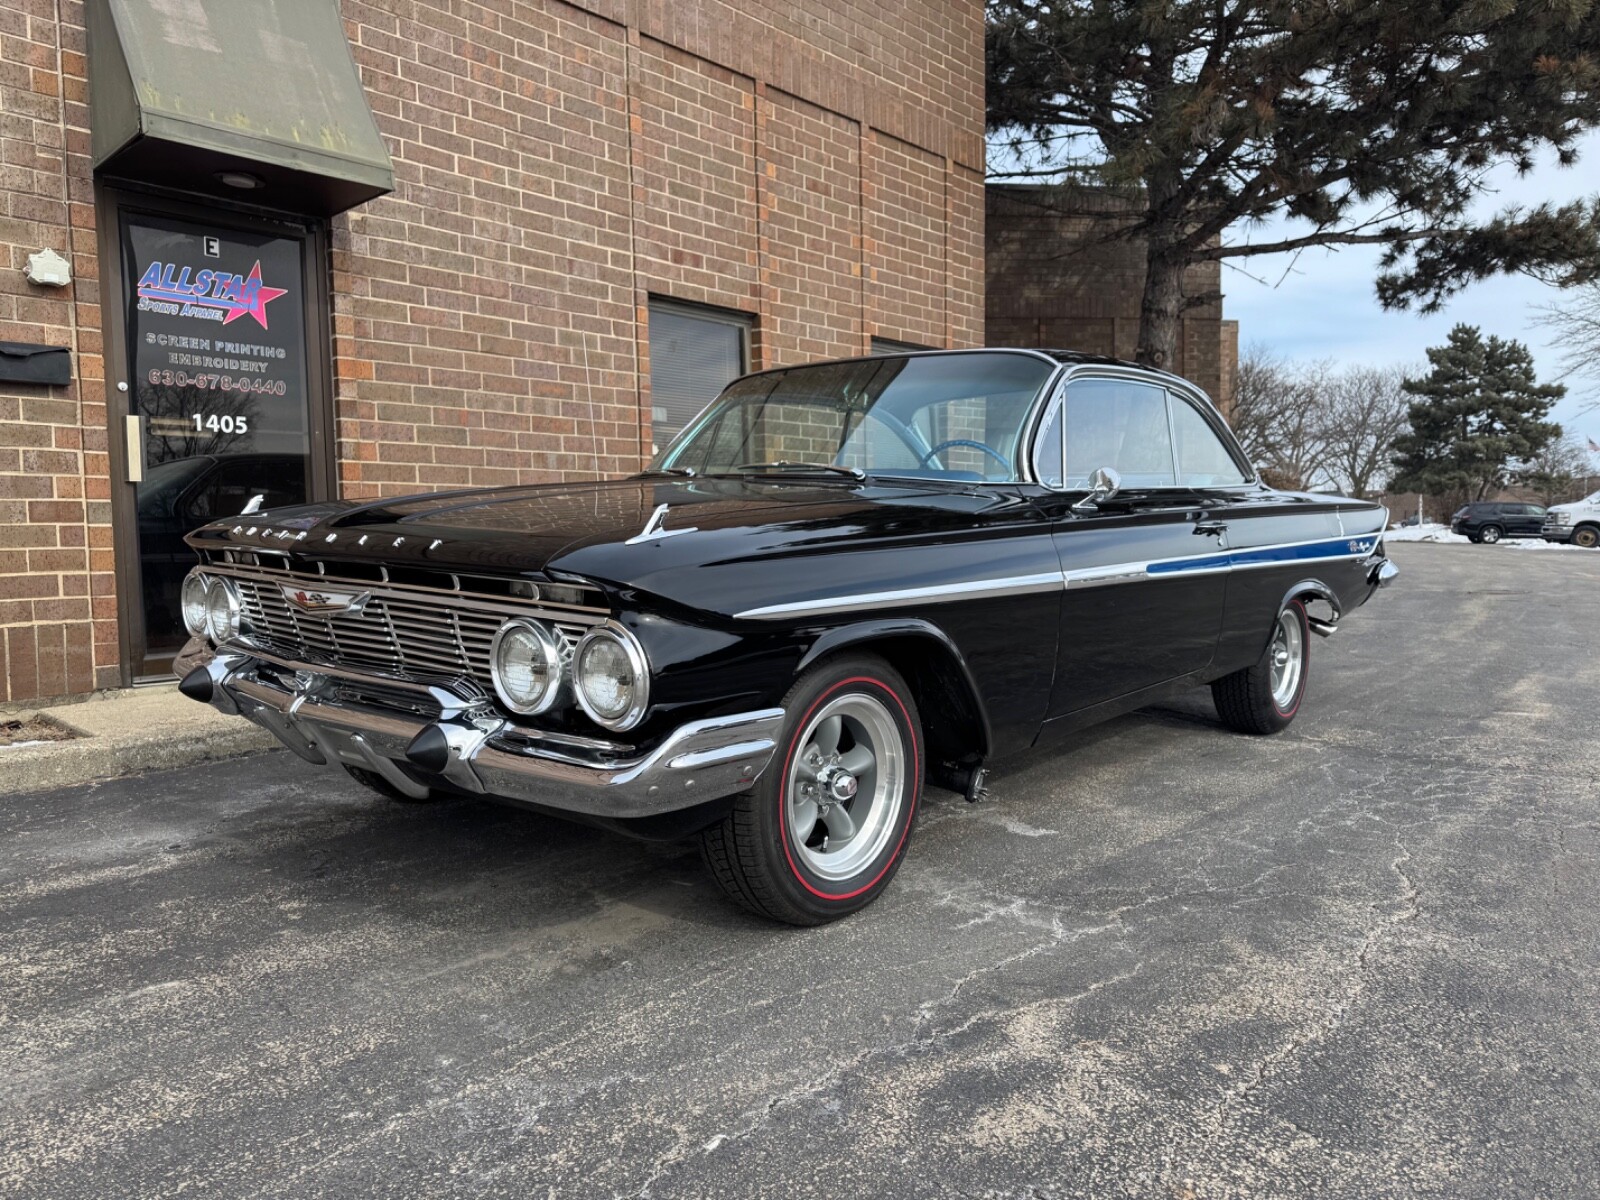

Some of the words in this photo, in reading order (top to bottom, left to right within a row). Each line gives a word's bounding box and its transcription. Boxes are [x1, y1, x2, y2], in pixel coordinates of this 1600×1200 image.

[205, 237, 219, 257] E
[138, 261, 262, 305] ALLSTAR
[137, 296, 178, 314] SPORTS
[180, 302, 224, 321] APPAREL
[146, 332, 210, 351] SCREEN
[215, 340, 286, 359] PRINTING
[168, 352, 268, 372] EMBROIDERY
[149, 369, 286, 396] 630-678-0440
[193, 413, 248, 434] 1405
